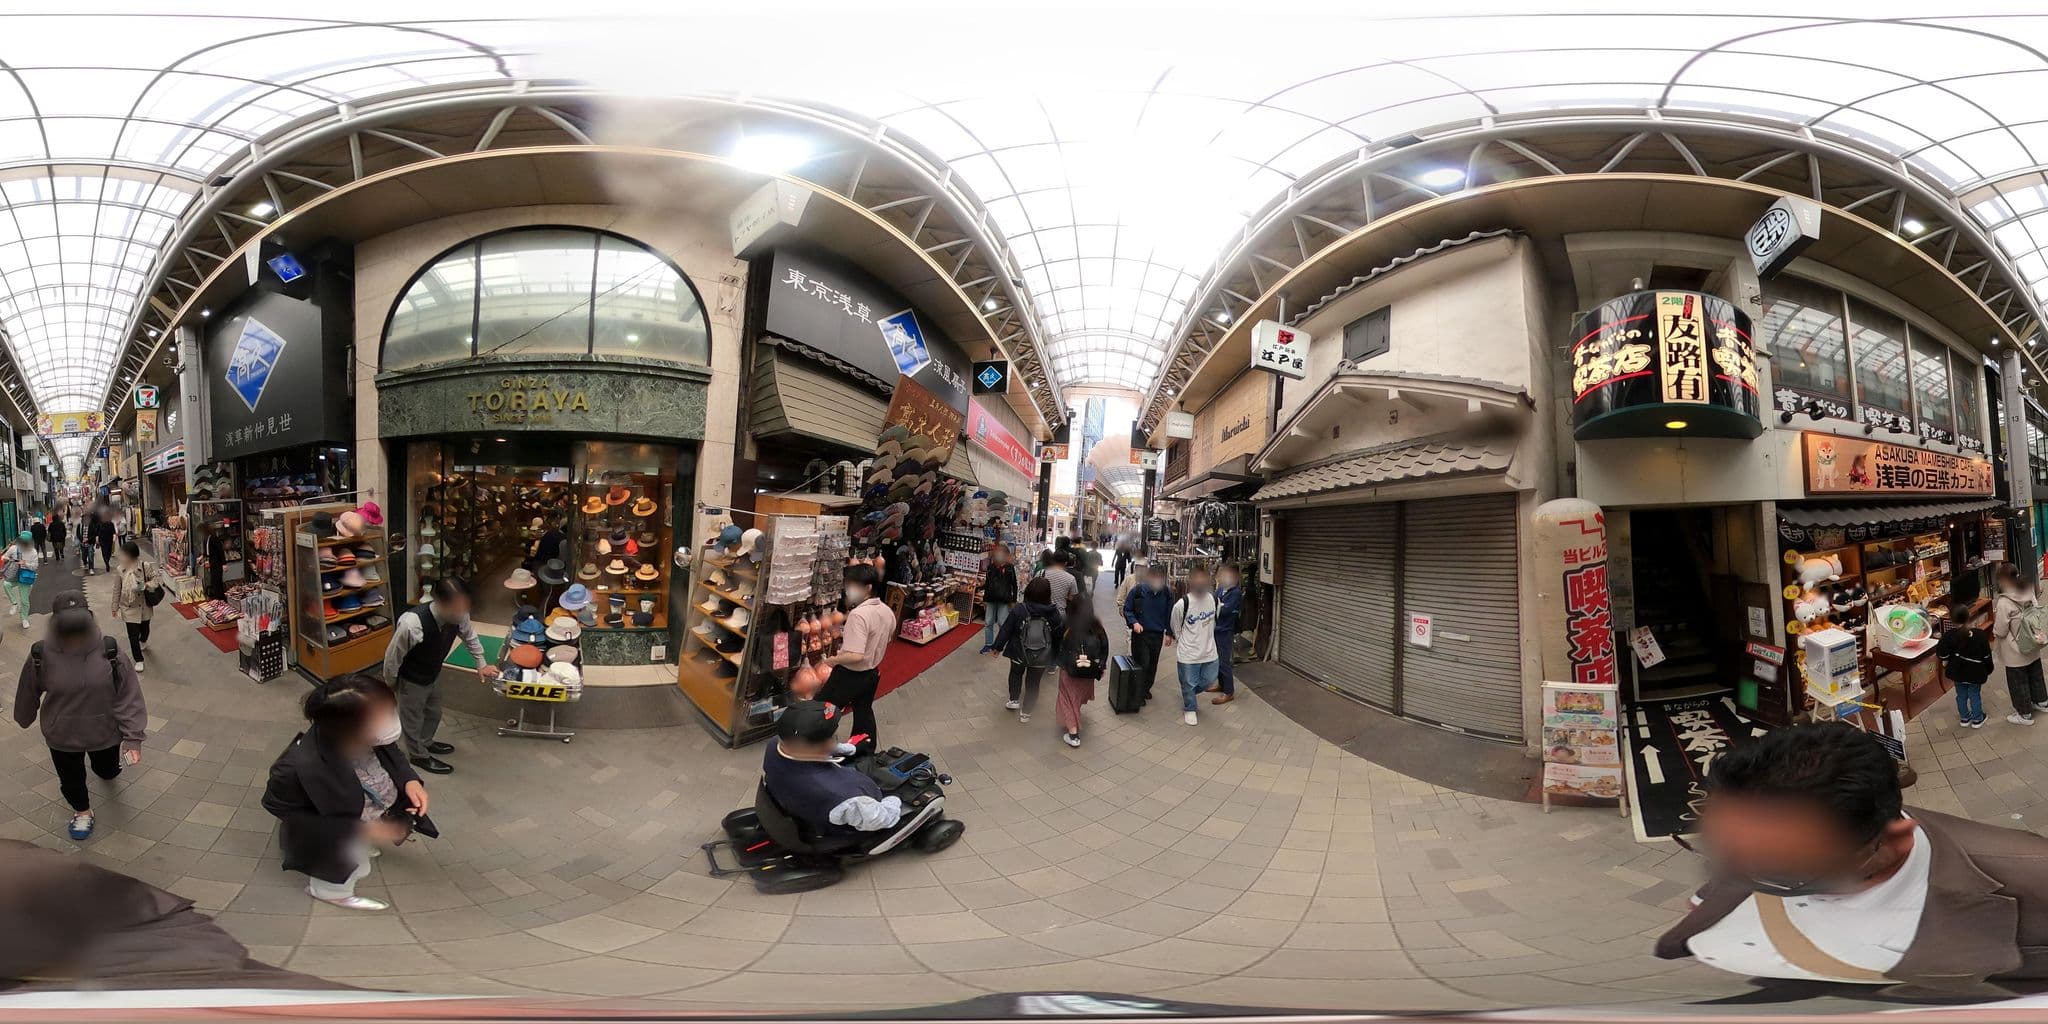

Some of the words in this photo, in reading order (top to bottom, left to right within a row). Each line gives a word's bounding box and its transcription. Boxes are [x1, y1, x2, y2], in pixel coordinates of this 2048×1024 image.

[782, 268, 873, 325] 東京浅草
[1662, 296, 1683, 306] 2階
[1261, 349, 1304, 370] 江戸屋
[1664, 315, 1703, 400] 友路有
[501, 378, 549, 391] GINZA
[467, 391, 589, 413] TORAYA
[224, 412, 292, 448] 浅草新仲見世
[2011, 415, 2019, 423] 13
[1874, 444, 1919, 465] ASAKUSA
[1921, 452, 1961, 470] MAMESHIBA
[1875, 445, 1975, 489] 浅草の豆柴カフェ
[509, 684, 564, 699] SALE
